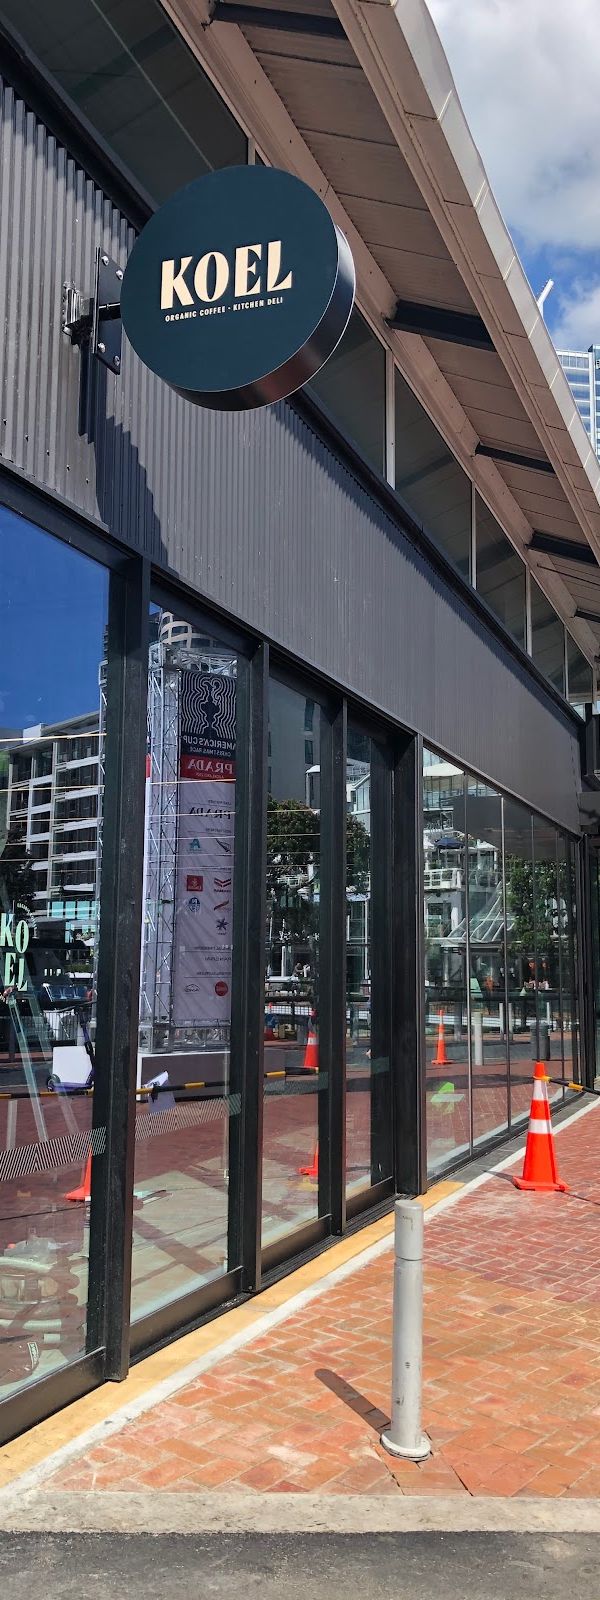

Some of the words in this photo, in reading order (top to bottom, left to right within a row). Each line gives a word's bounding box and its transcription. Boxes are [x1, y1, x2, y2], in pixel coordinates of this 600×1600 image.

[160, 240, 292, 310] KOEL
[165, 311, 197, 322] ORGANIC
[199, 306, 226, 317] COFFEE
[233, 299, 264, 311] KITCHEN
[267, 296, 283, 305] DELI
[0, 912, 29, 954] KO
[4, 952, 28, 992] EL
